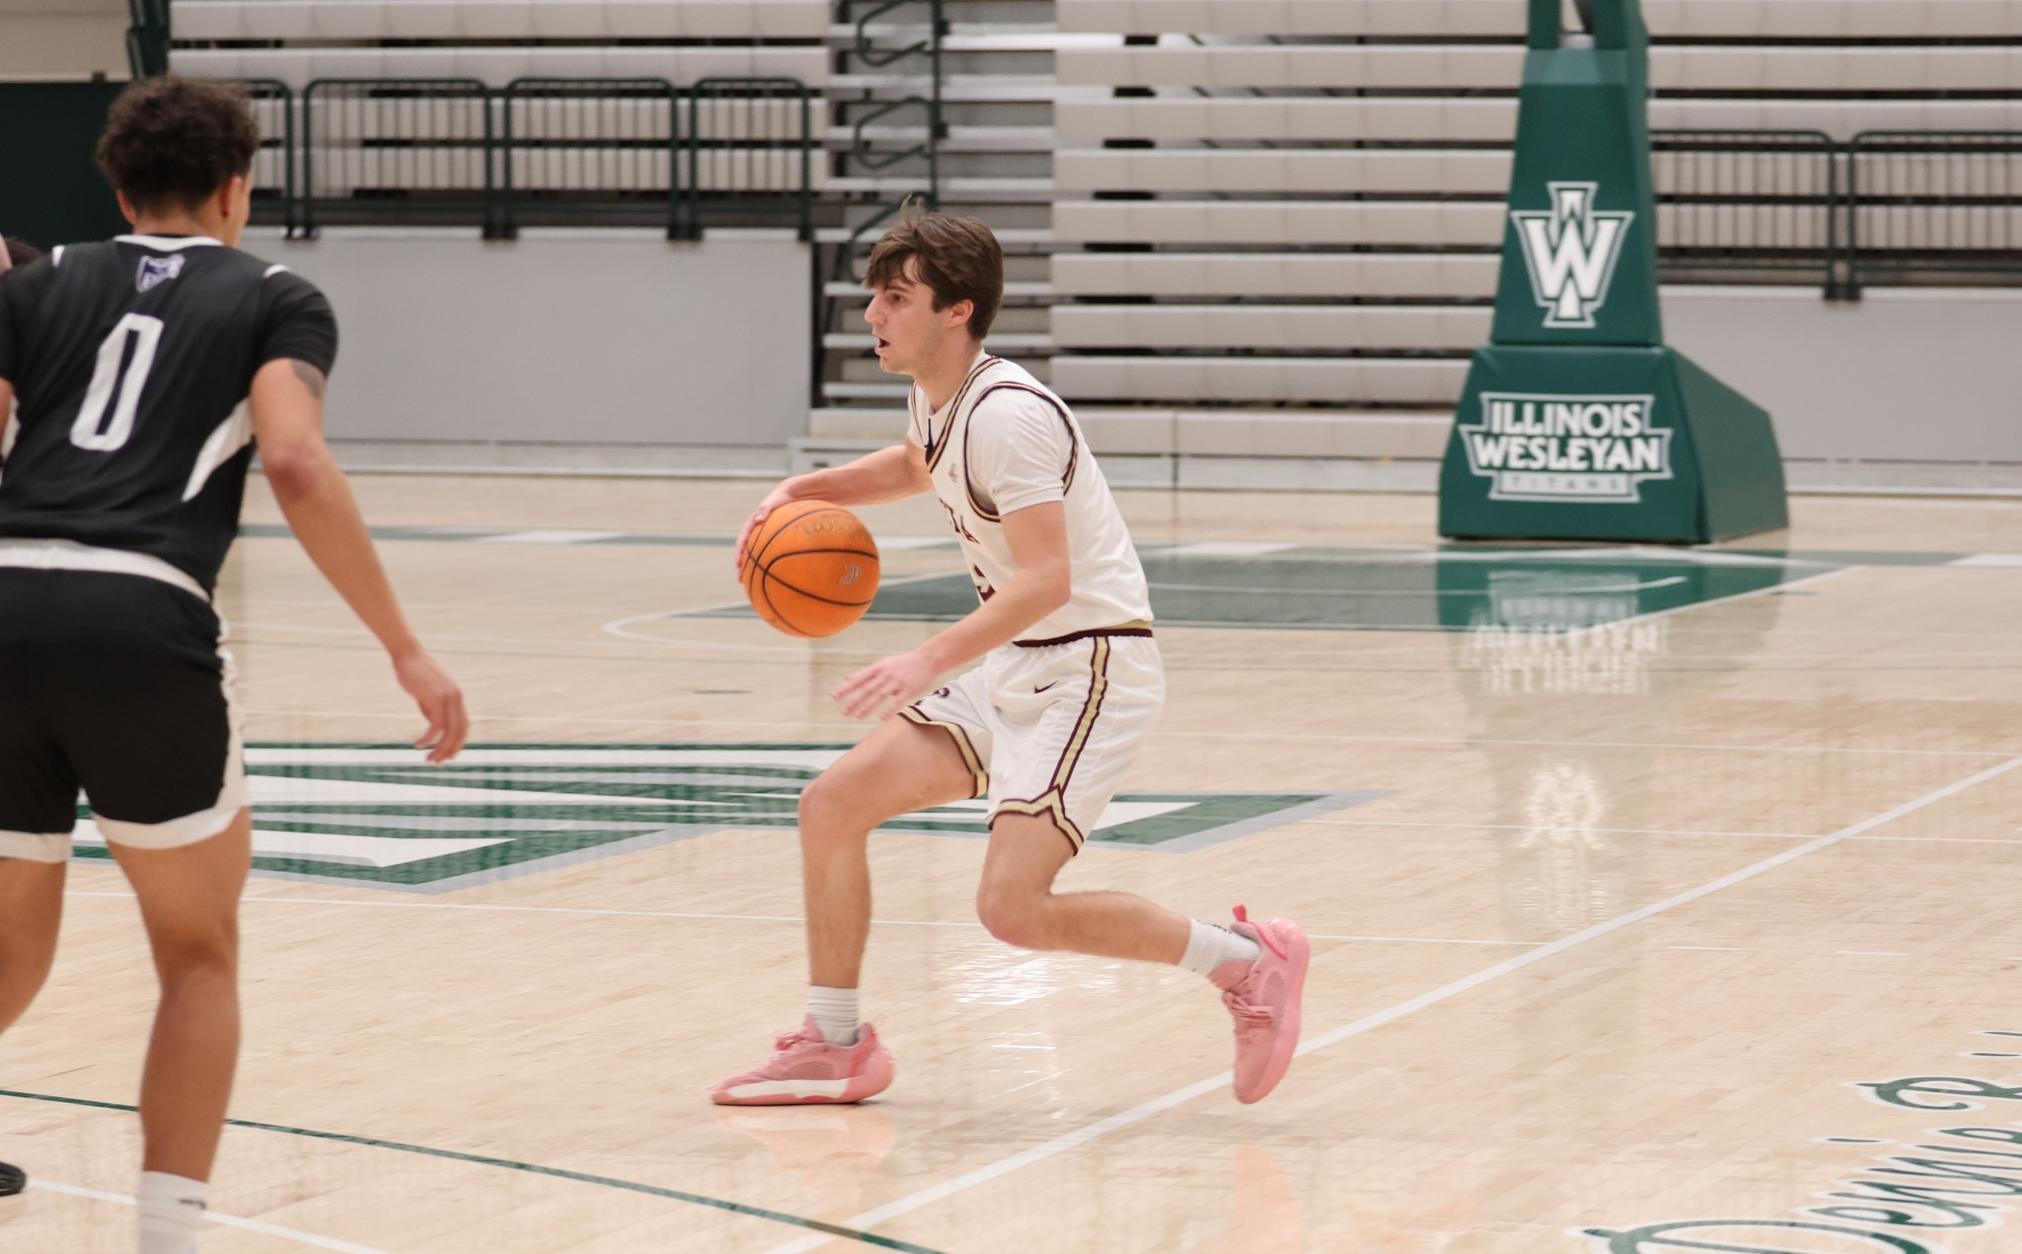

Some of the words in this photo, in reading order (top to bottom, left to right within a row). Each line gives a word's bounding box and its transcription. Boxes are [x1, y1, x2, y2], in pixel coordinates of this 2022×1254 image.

[70, 312, 164, 451] 0
[1490, 401, 1643, 437] ILLINOIS
[1471, 433, 1661, 472] WESLEYAN
[1511, 475, 1619, 491] TITANS
